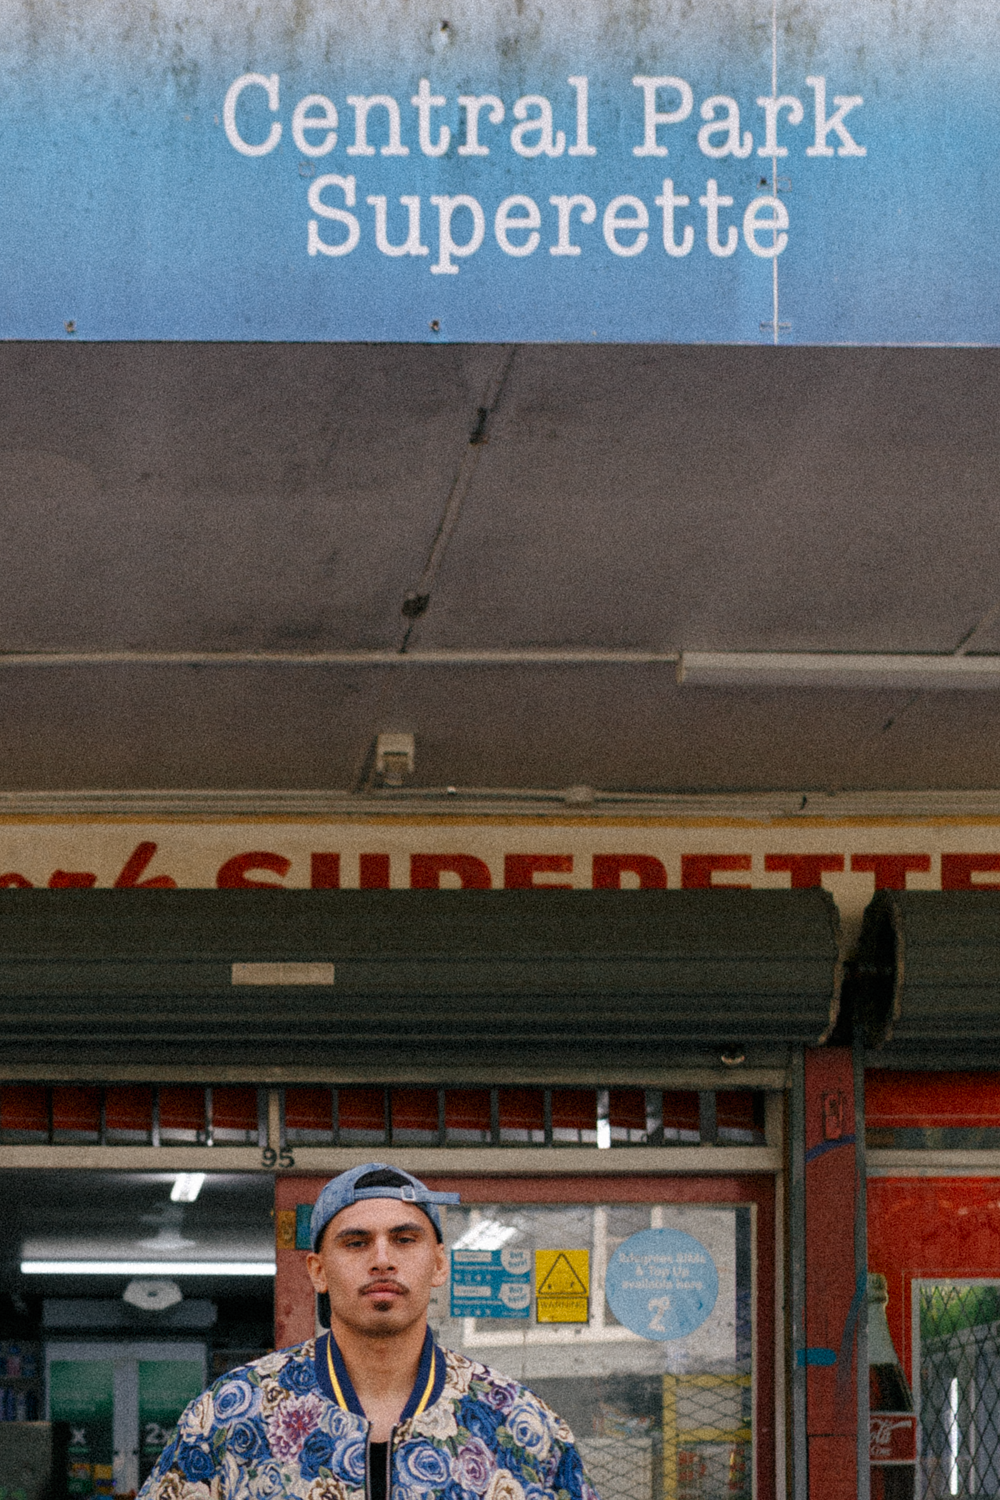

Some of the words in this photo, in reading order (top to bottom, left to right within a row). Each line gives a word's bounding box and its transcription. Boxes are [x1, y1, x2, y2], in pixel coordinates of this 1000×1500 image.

[222, 73, 596, 157] Central
[633, 74, 867, 157] Park
[306, 174, 790, 274] Superette
[259, 1147, 295, 1170] 95
[648, 1265, 670, 1278] Top
[672, 1266, 690, 1278] Up
